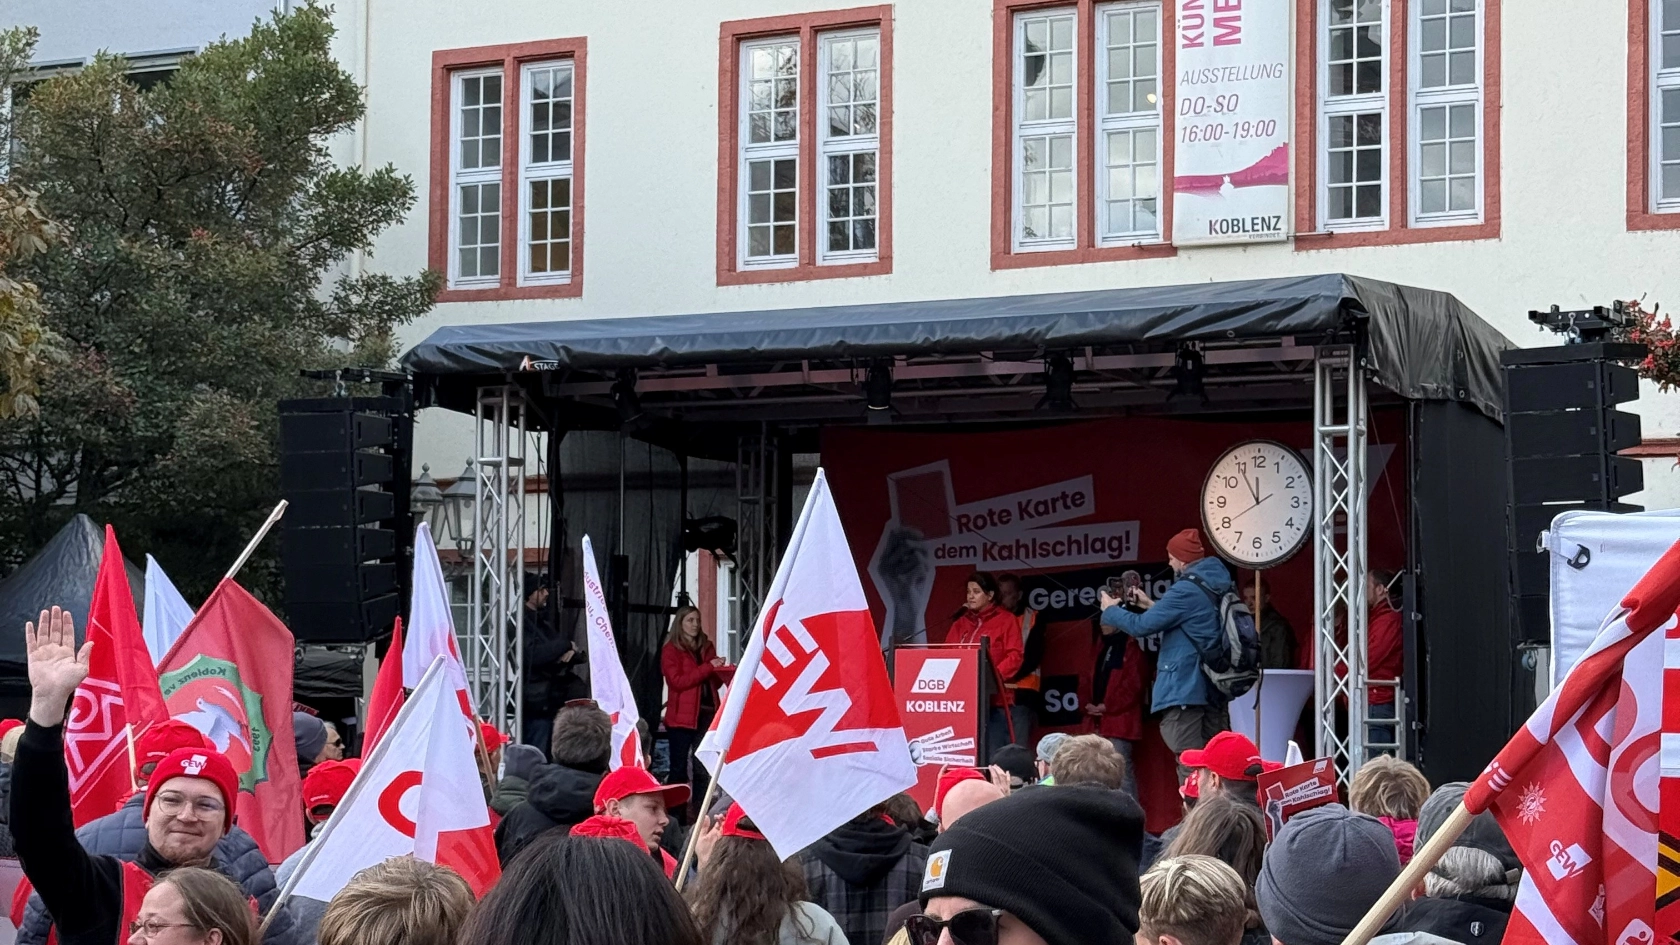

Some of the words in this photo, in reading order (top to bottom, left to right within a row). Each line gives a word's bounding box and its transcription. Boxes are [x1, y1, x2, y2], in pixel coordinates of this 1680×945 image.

[1180, 63, 1284, 86] AUSSTELLUNG
[1180, 94, 1239, 116] DO-SO
[1181, 120, 1276, 143] 16:00-19:00
[1209, 216, 1282, 235] KOBLENZ
[1235, 461, 1247, 474] 11
[1251, 455, 1267, 468] 12
[1274, 461, 1280, 474] 1
[1222, 476, 1238, 489] 10
[1285, 476, 1295, 489] 2
[1216, 495, 1227, 508] 9
[1290, 496, 1300, 509] 3
[957, 507, 1012, 534] Rote
[1017, 490, 1086, 521] Karte
[1221, 516, 1232, 529] 8
[1285, 516, 1294, 529] 4
[1234, 531, 1243, 543] 7
[1252, 537, 1262, 549] 6
[1271, 531, 1281, 543] 5
[934, 543, 977, 559] dem
[982, 530, 1131, 560] Kahlschlag!
[918, 679, 946, 690] DGB
[906, 701, 966, 713] KOBLENZ
[180, 760, 207, 770] GEW
[1285, 789, 1299, 799] Rote
[1300, 781, 1316, 791] Karte
[1549, 840, 1584, 878] GEW
